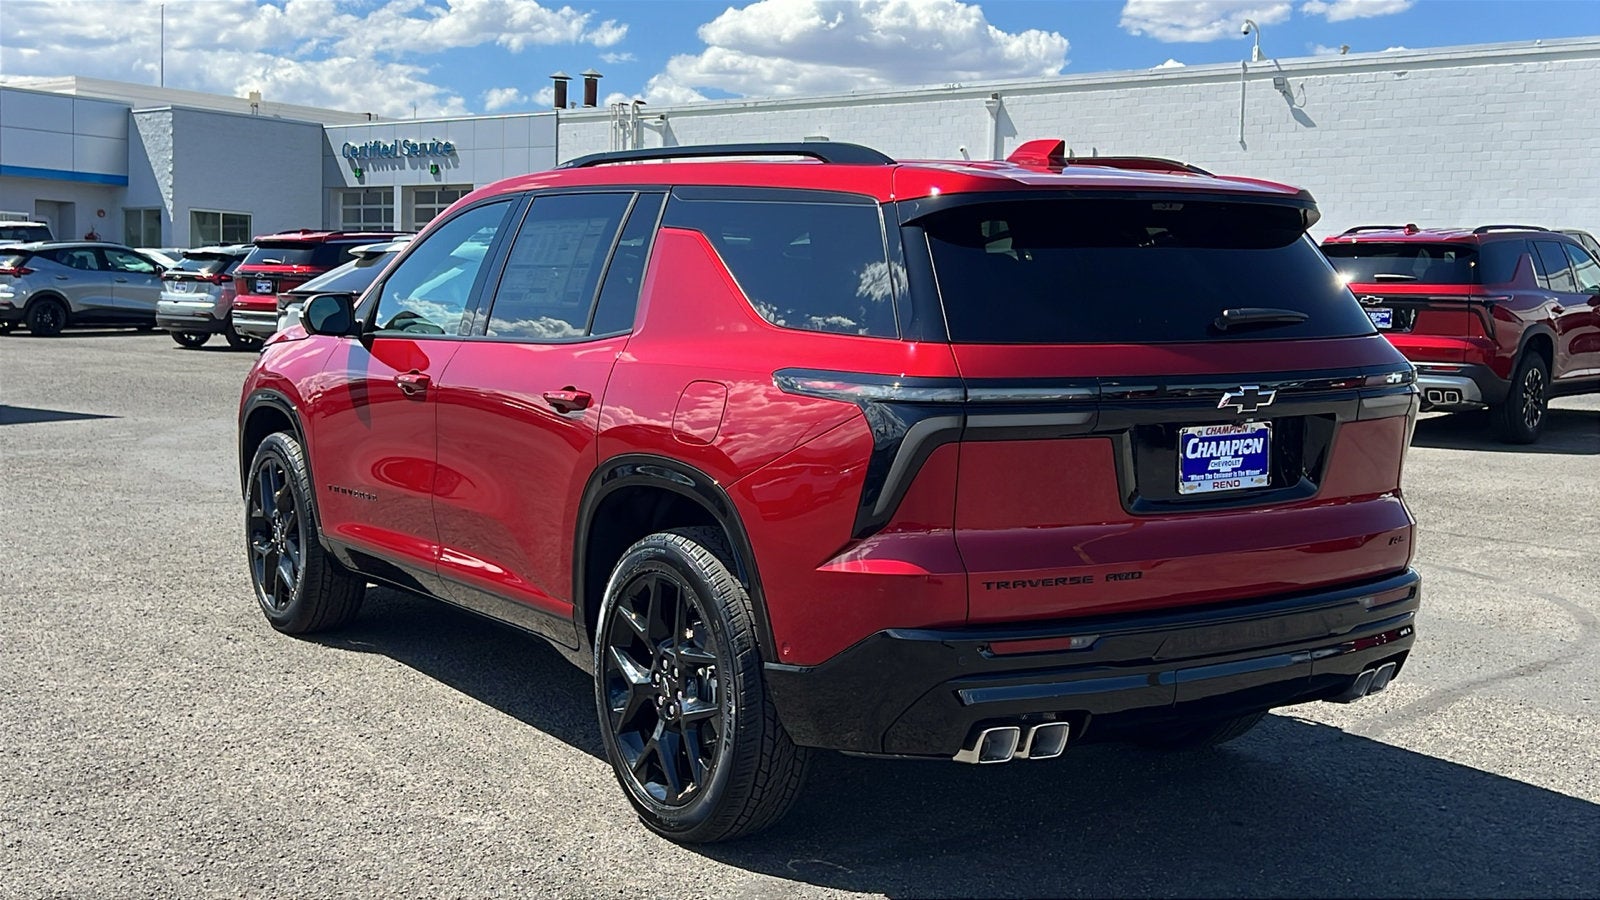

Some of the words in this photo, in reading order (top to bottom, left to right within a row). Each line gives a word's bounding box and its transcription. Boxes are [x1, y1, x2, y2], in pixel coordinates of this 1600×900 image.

[342, 139, 398, 159] Certified
[402, 138, 452, 157] Service
[1205, 425, 1249, 435] CHAMPION
[1186, 438, 1264, 459] CHAMPION
[1210, 459, 1241, 468] CHEVROLET
[1212, 480, 1241, 489] RENO
[982, 575, 1094, 590] TRAVERSE
[1105, 570, 1144, 582] AWD
